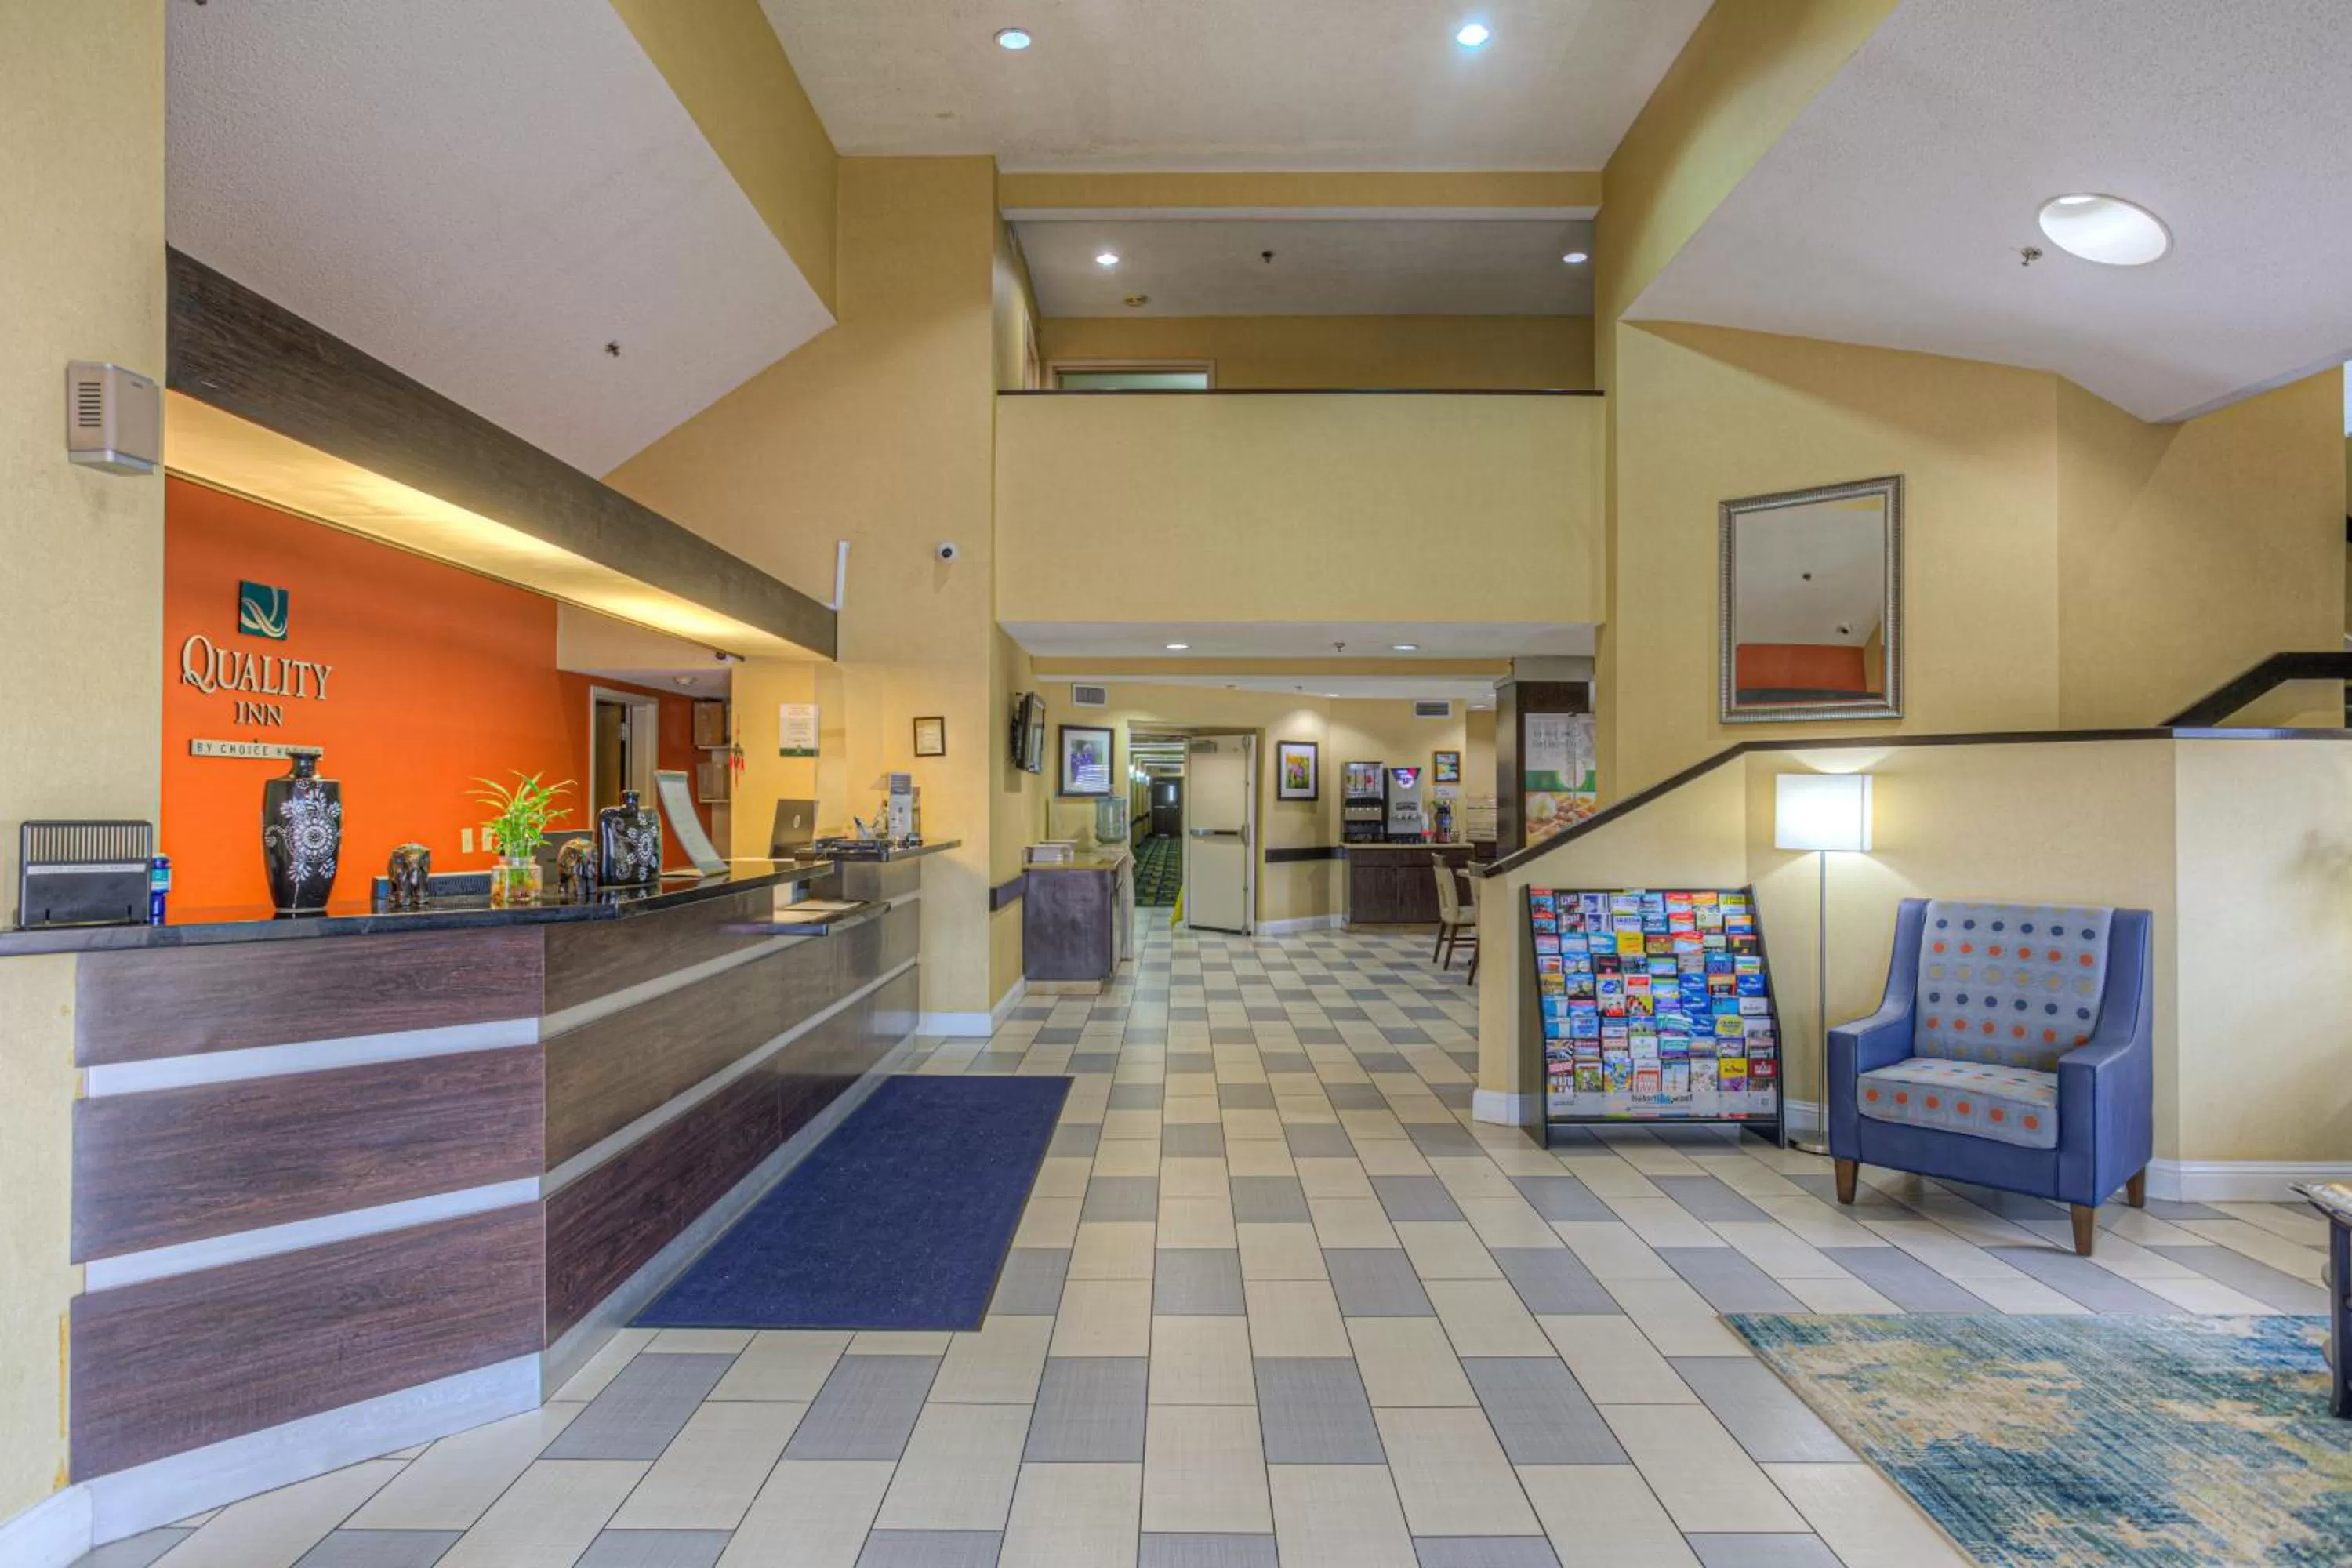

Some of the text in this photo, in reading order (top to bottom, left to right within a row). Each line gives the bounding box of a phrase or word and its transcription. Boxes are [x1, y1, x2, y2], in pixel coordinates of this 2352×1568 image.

[182, 634, 333, 700] QUALITY
[235, 702, 283, 727] INN
[197, 742, 212, 753] BY
[220, 744, 269, 756] CHOICE
